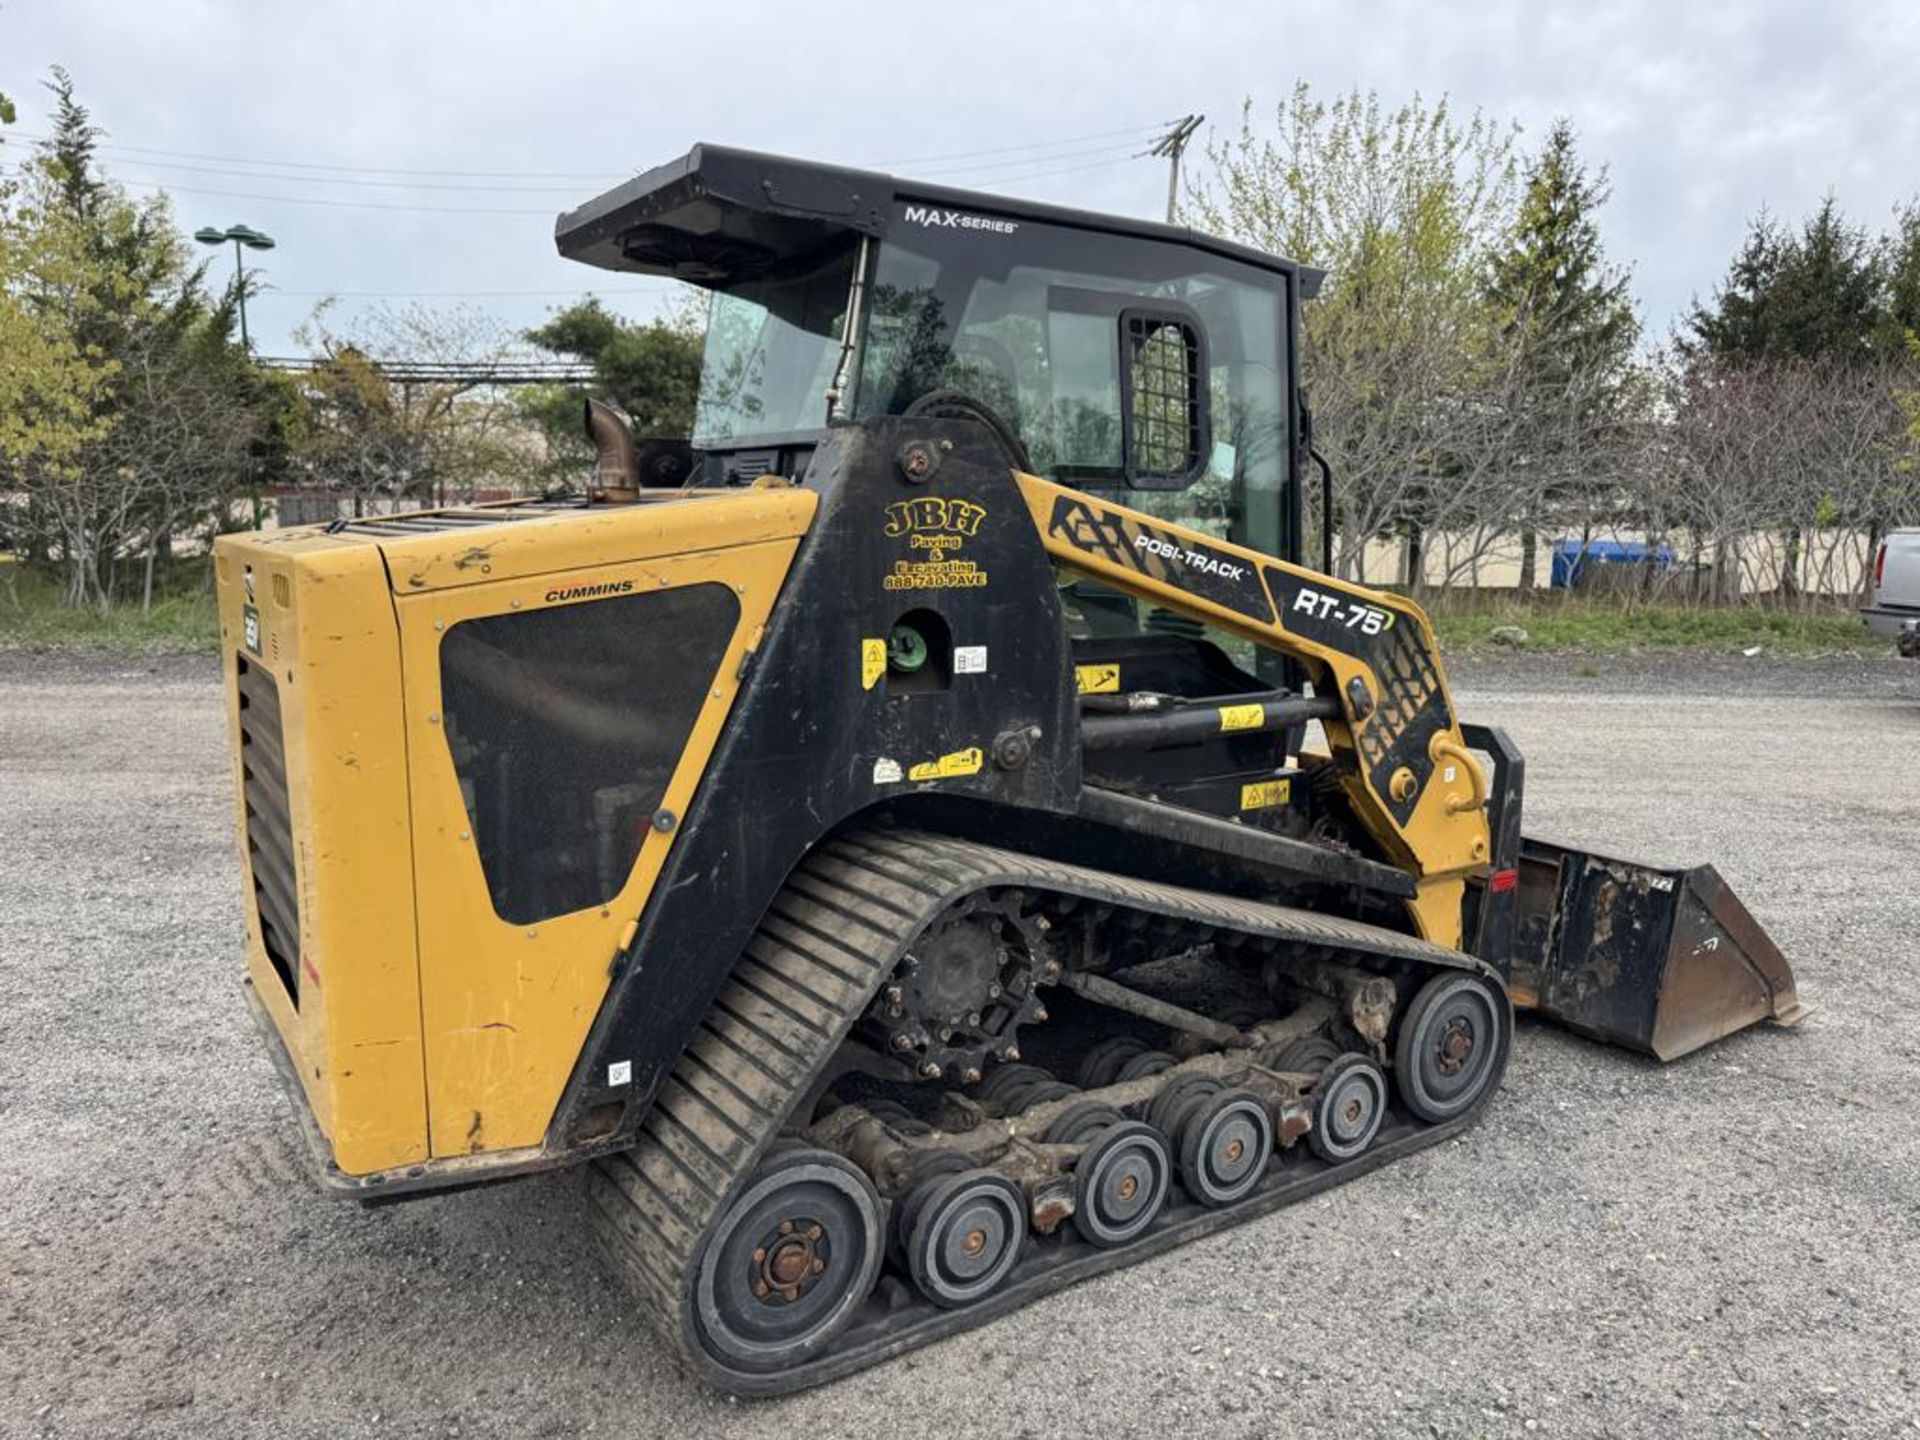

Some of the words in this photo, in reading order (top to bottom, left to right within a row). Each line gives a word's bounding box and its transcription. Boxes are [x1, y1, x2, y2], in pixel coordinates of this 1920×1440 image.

[884, 497, 987, 537] JBH
[910, 534, 962, 550] Paving
[929, 549, 944, 561] &
[1134, 535, 1242, 581] POSI-TRACK
[895, 560, 976, 575] Excavating
[545, 580, 633, 602] CUMMINS
[1293, 588, 1385, 635] RT-75
